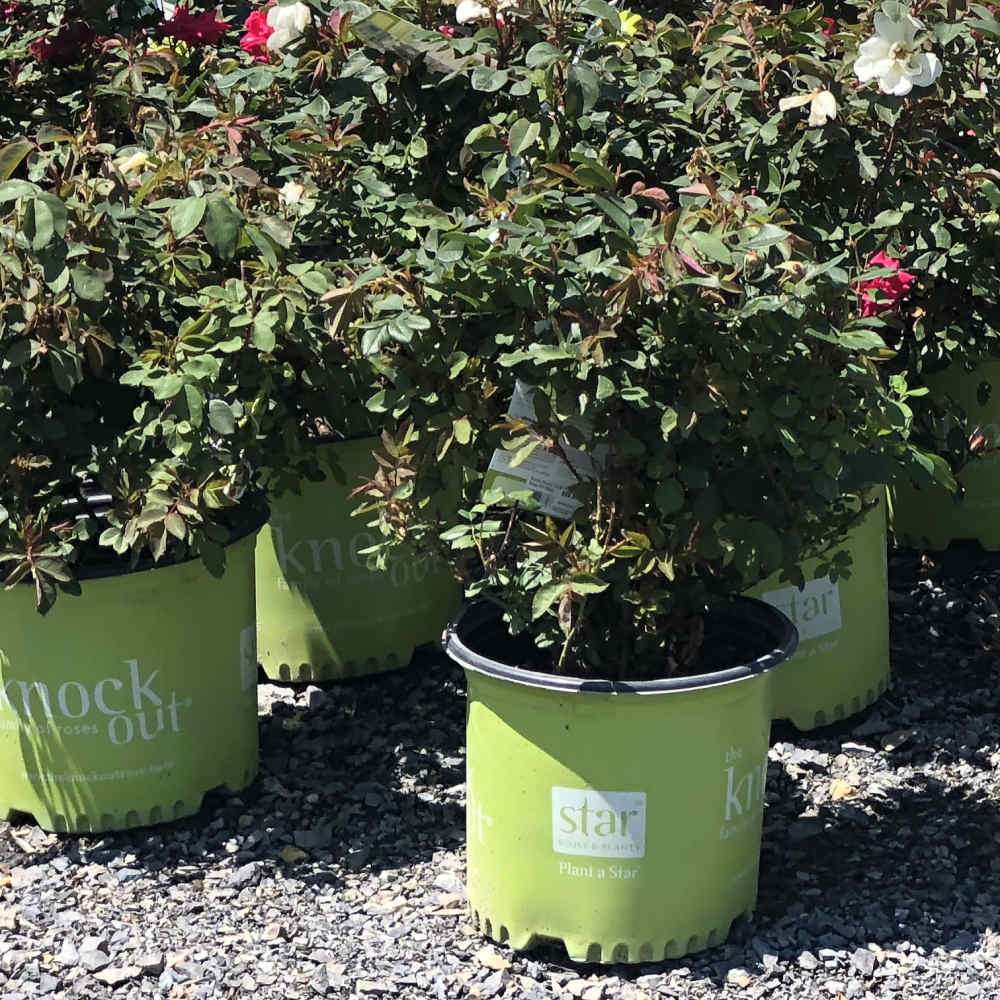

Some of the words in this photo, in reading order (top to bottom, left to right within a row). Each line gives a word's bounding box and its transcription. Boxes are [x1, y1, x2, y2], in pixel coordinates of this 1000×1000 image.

[108, 691, 181, 745] out
[559, 796, 639, 838] star
[559, 861, 592, 878] Plant
[609, 863, 638, 879] Star
